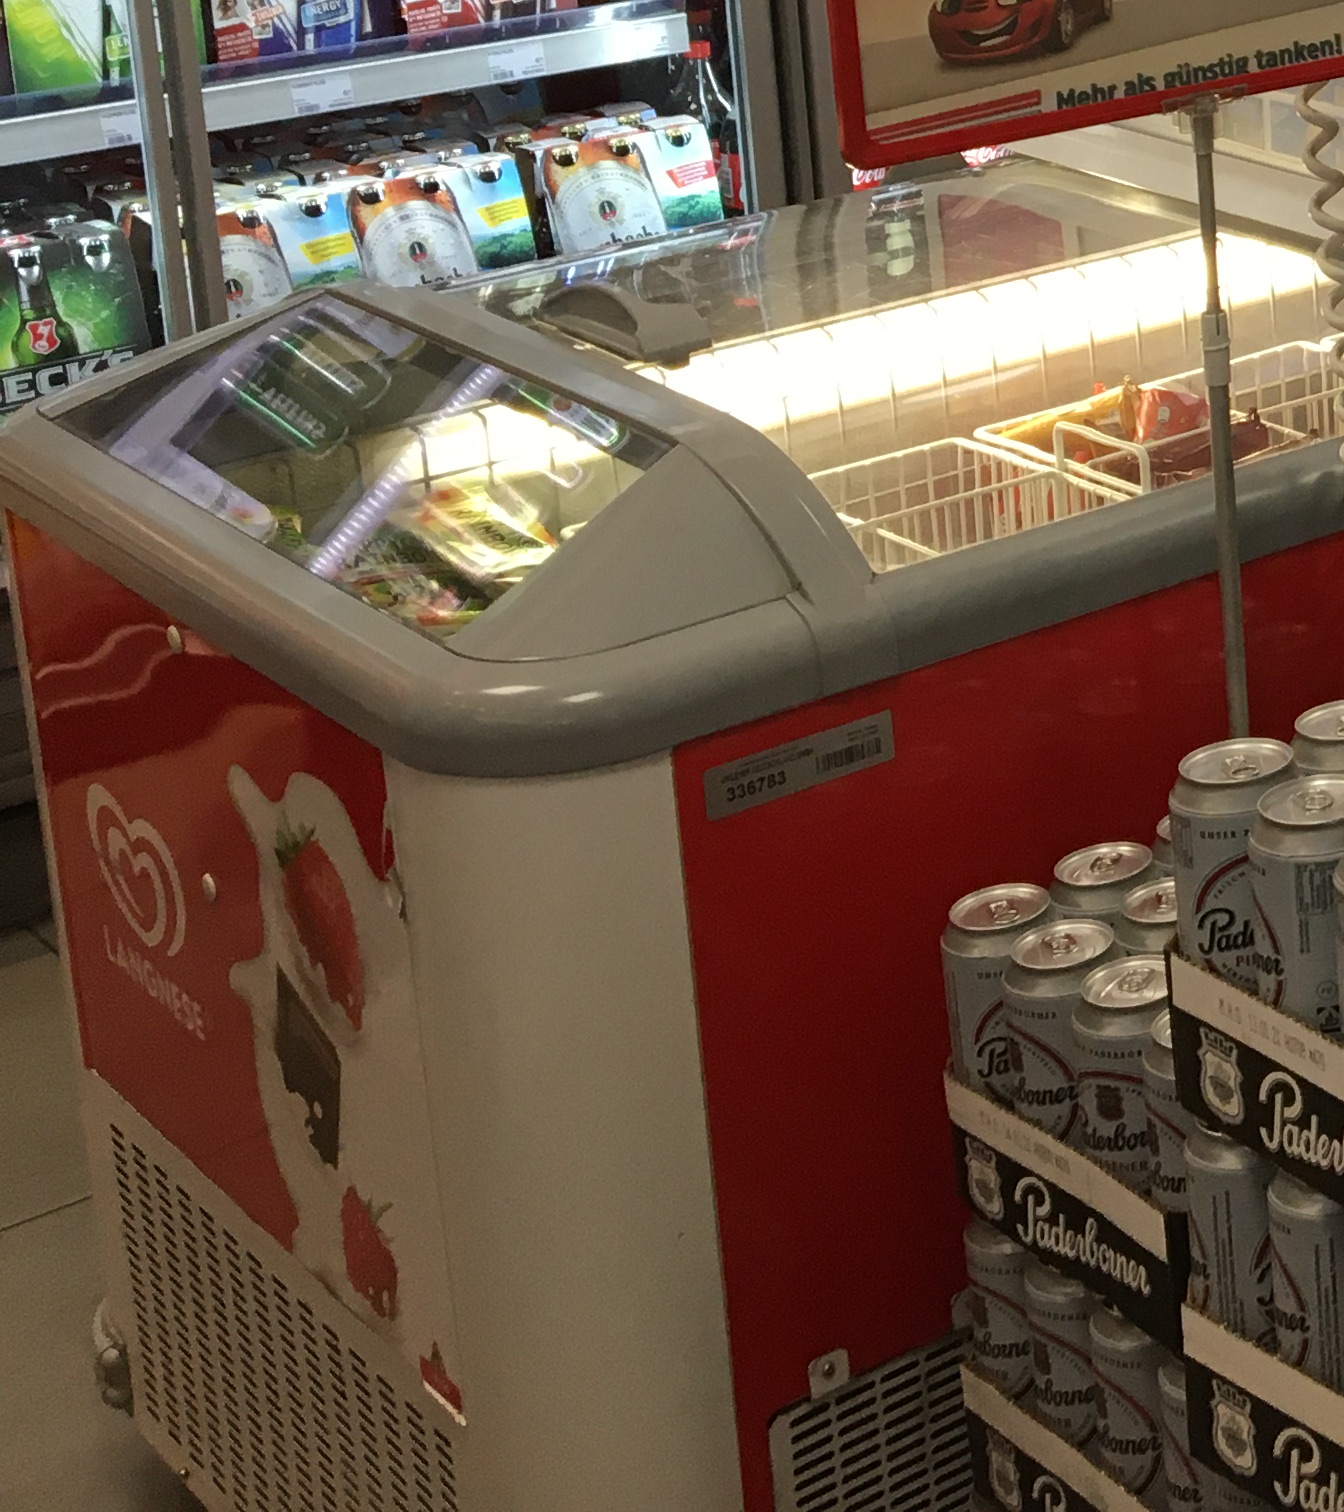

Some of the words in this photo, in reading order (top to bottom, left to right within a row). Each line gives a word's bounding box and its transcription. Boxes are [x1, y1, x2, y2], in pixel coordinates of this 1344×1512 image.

[1055, 81, 1118, 112] Mehr
[1125, 75, 1156, 99] als
[1162, 50, 1249, 90] günstig
[1254, 32, 1344, 72] tanken!
[726, 770, 787, 802] 336783
[100, 925, 208, 1041] LANGNESE
[1014, 1175, 1152, 1297] Paderborner
